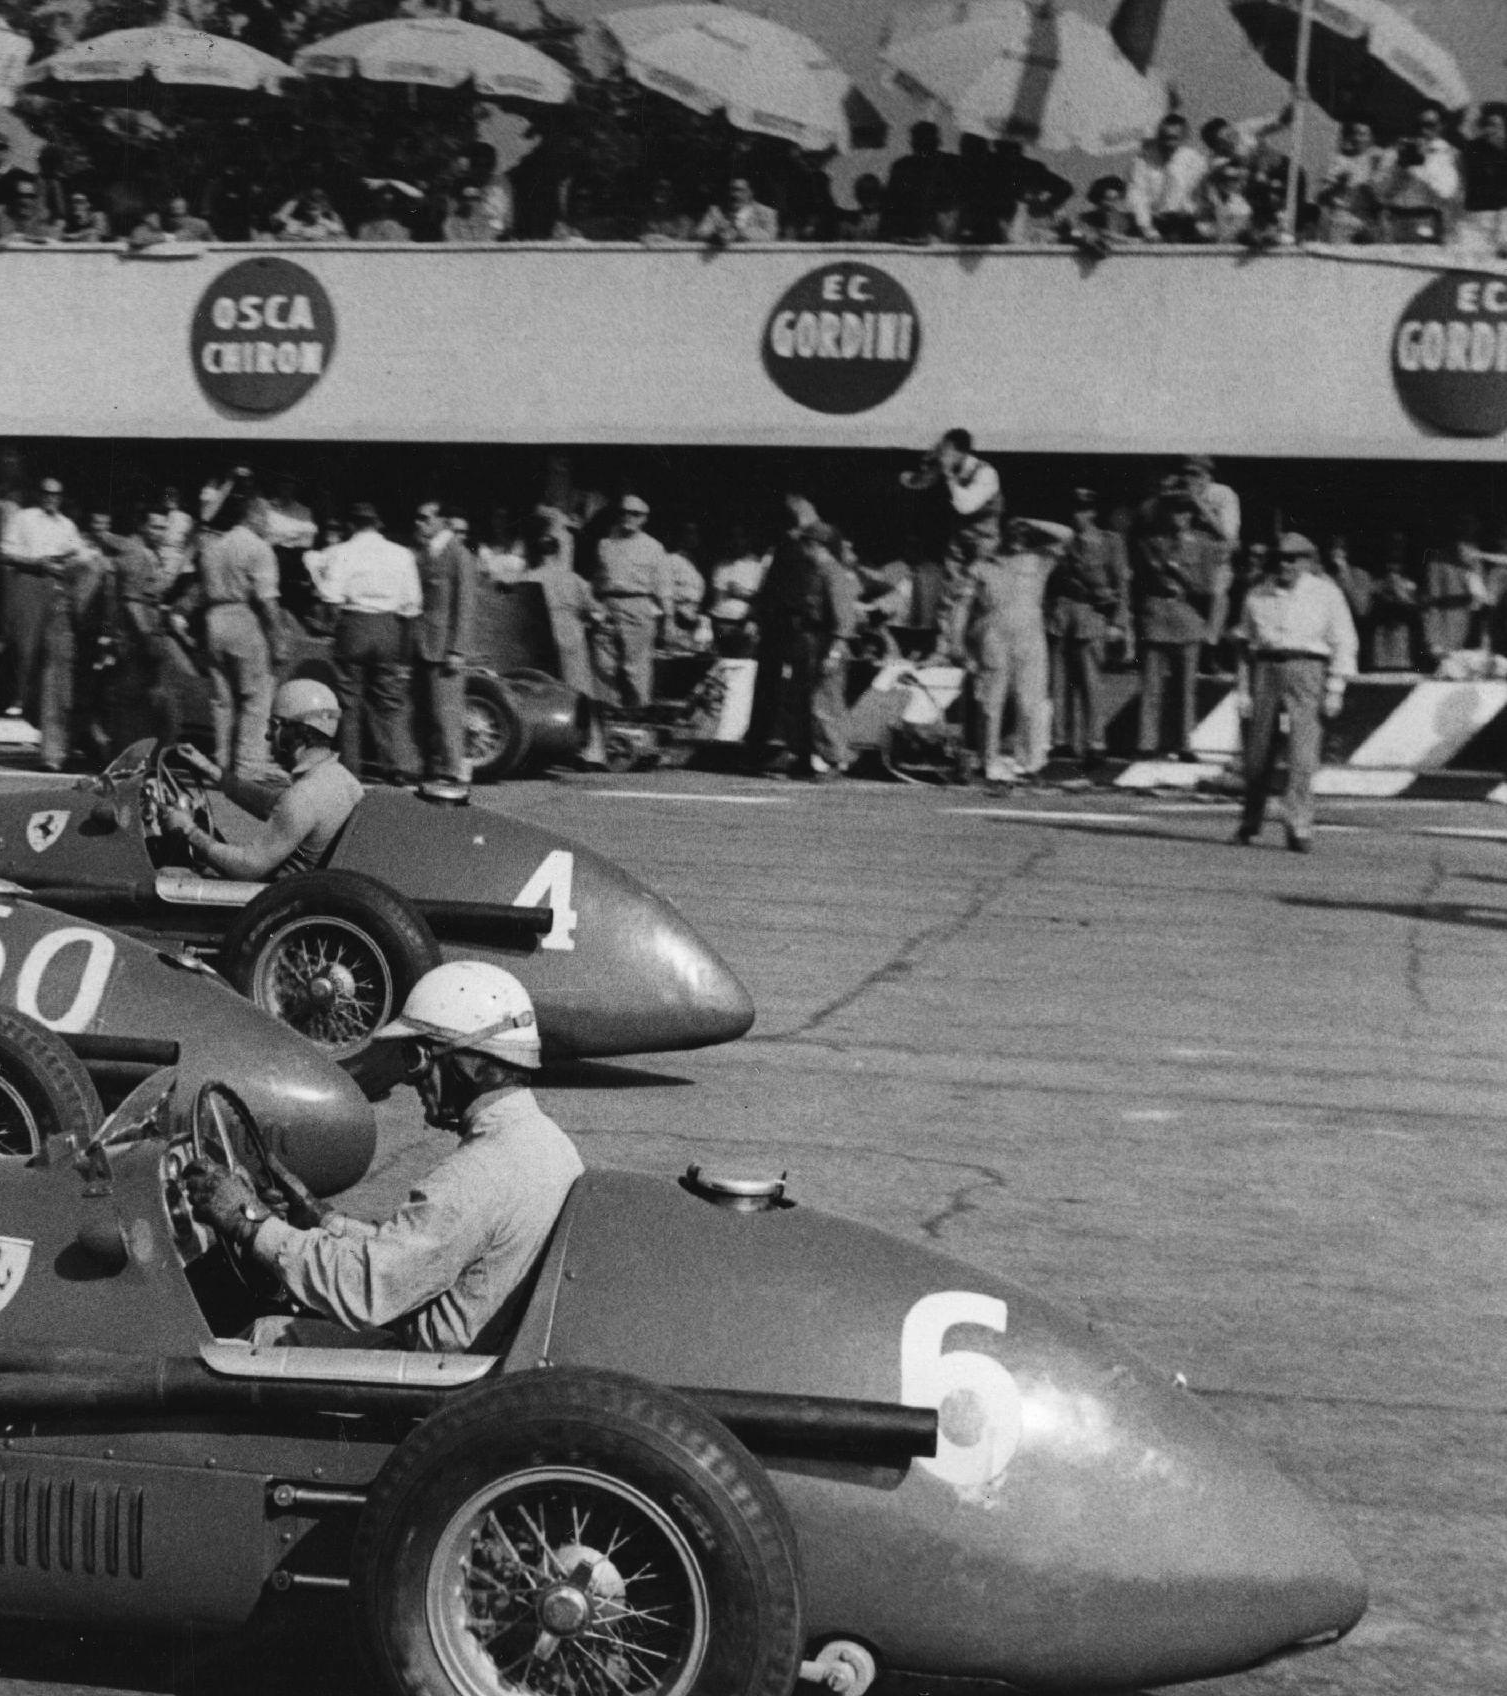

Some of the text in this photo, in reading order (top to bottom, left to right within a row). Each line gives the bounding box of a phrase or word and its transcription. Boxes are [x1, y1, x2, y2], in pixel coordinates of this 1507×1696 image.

[822, 274, 874, 301] EC
[1456, 281, 1507, 312] EC
[212, 294, 315, 330] OSCA
[770, 309, 913, 361] GORDINI
[201, 341, 323, 374] CHIRON
[512, 850, 577, 951] 4
[901, 1290, 1022, 1486] 6
